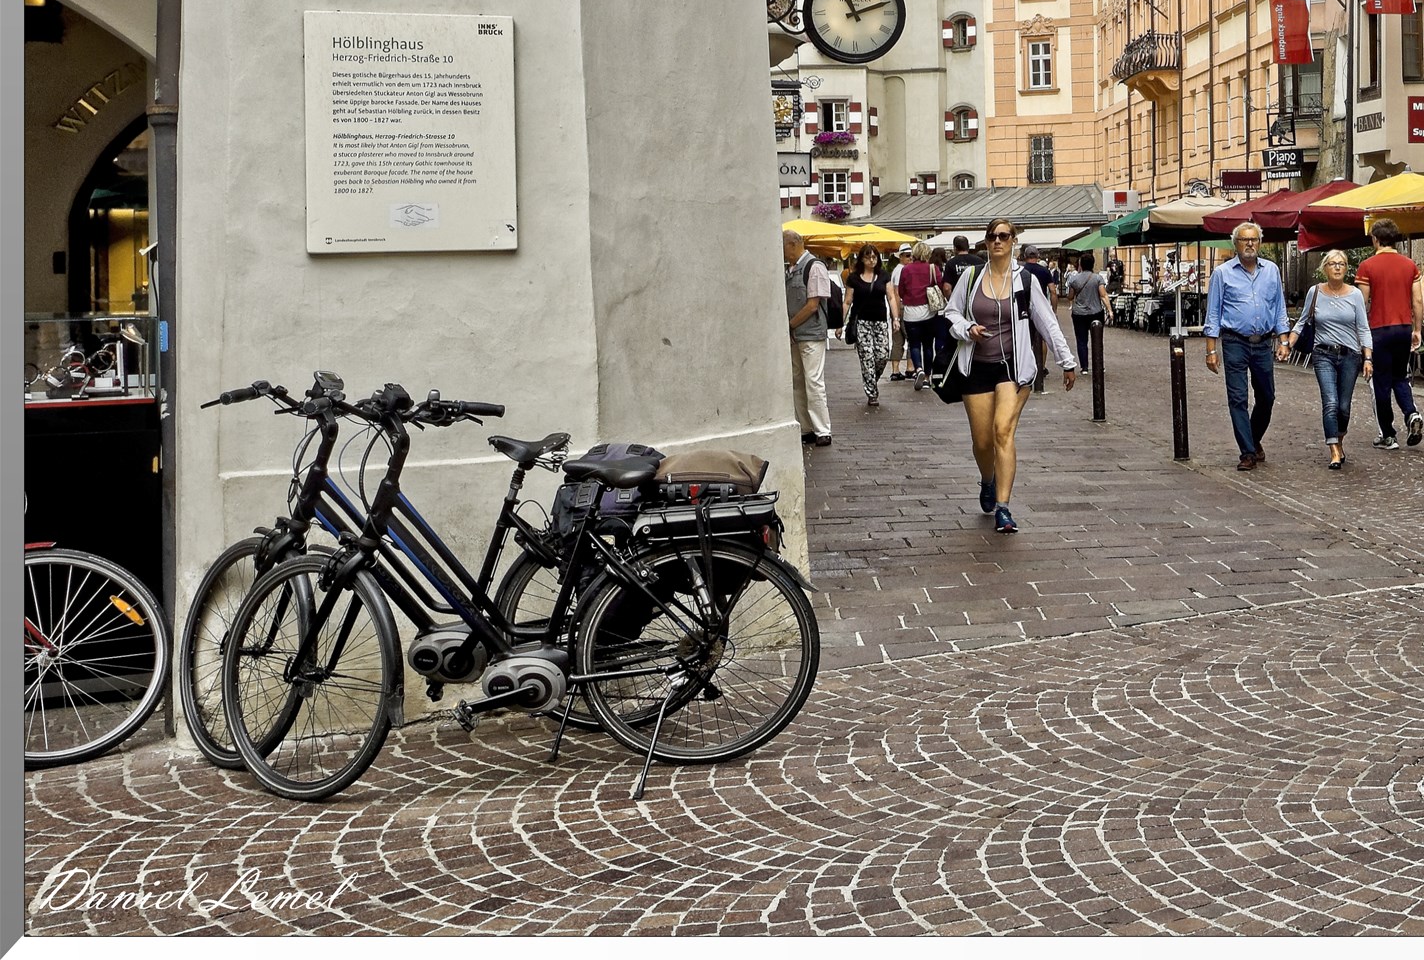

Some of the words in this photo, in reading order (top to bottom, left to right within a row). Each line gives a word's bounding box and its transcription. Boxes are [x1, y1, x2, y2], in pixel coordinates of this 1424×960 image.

[332, 36, 424, 53] Hölblinghaus
[332, 53, 440, 64] Herzog-Friedrich-Straße
[1358, 113, 1382, 132] BANK
[1269, 151, 1296, 166] Piano
[1267, 170, 1301, 179] Restaurant
